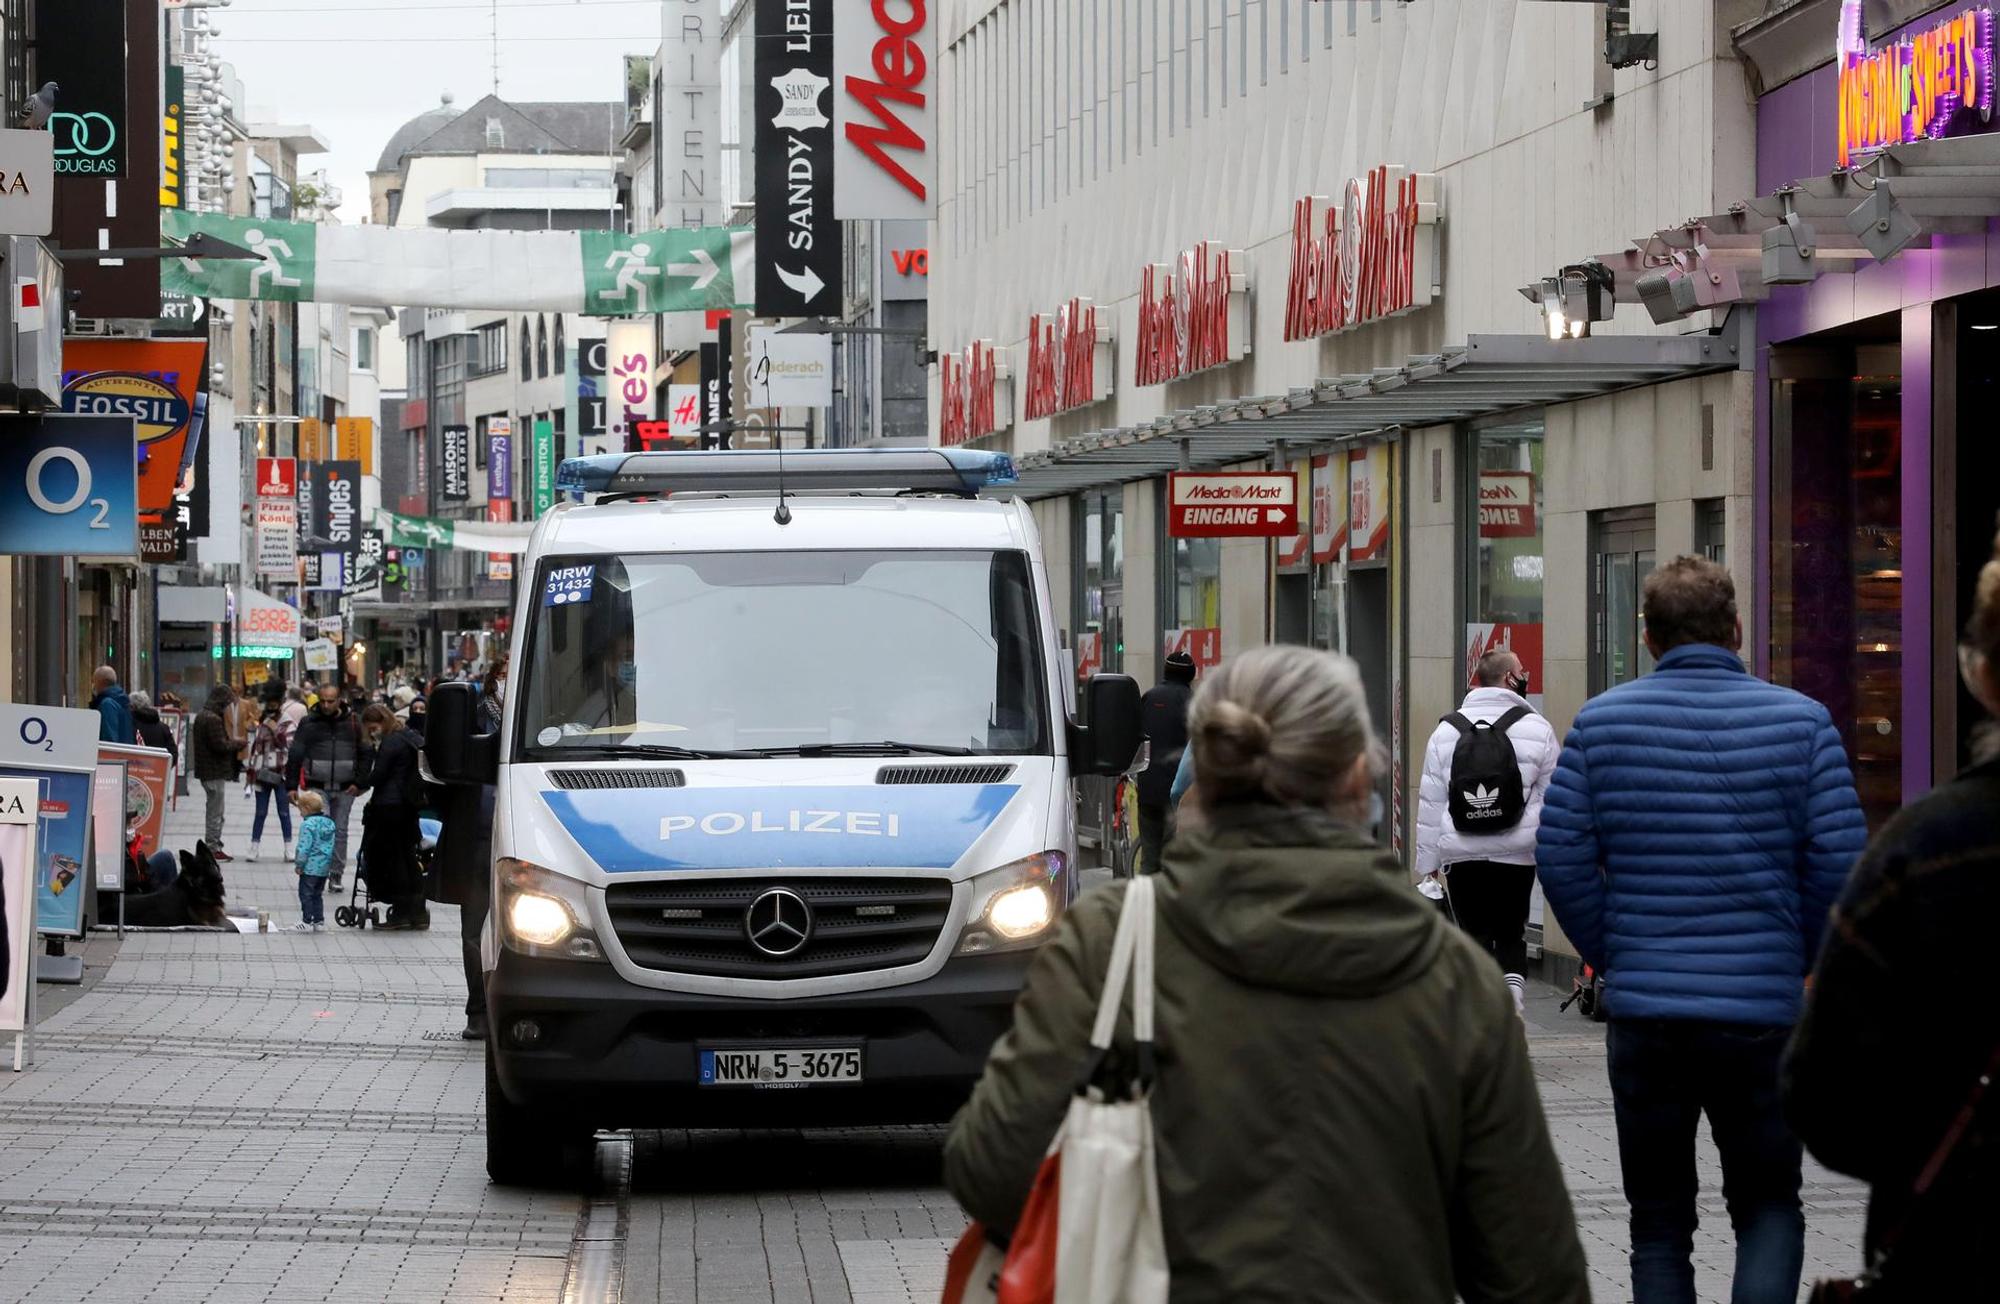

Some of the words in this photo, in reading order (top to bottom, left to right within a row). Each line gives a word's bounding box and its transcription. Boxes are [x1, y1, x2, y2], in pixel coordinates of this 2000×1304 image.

[1910, 9, 1977, 137] SWEETS
[784, 84, 816, 100] SANDY
[788, 135, 813, 251] SANDY
[86, 377, 165, 396] AUTHENTIC
[74, 395, 178, 423] FOSSIL
[613, 354, 648, 451] ire's
[445, 430, 457, 495] MAISONS
[538, 435, 549, 490] BENETTON
[1186, 484, 1232, 499] Media
[1241, 484, 1282, 499] Markt
[261, 502, 291, 512] Pizza
[538, 493, 549, 509] OF
[259, 512, 294, 524] König
[329, 479, 355, 543] snipes
[1182, 507, 1259, 525] EINGANG
[550, 565, 593, 582] NRW
[547, 578, 592, 593] 31432
[250, 608, 291, 620] FOOD
[243, 620, 297, 634] LOUNGE
[1466, 808, 1503, 820] adidas
[659, 810, 900, 841] POLIZEI
[714, 1053, 761, 1080] NRW
[773, 1051, 860, 1079] 5-3675
